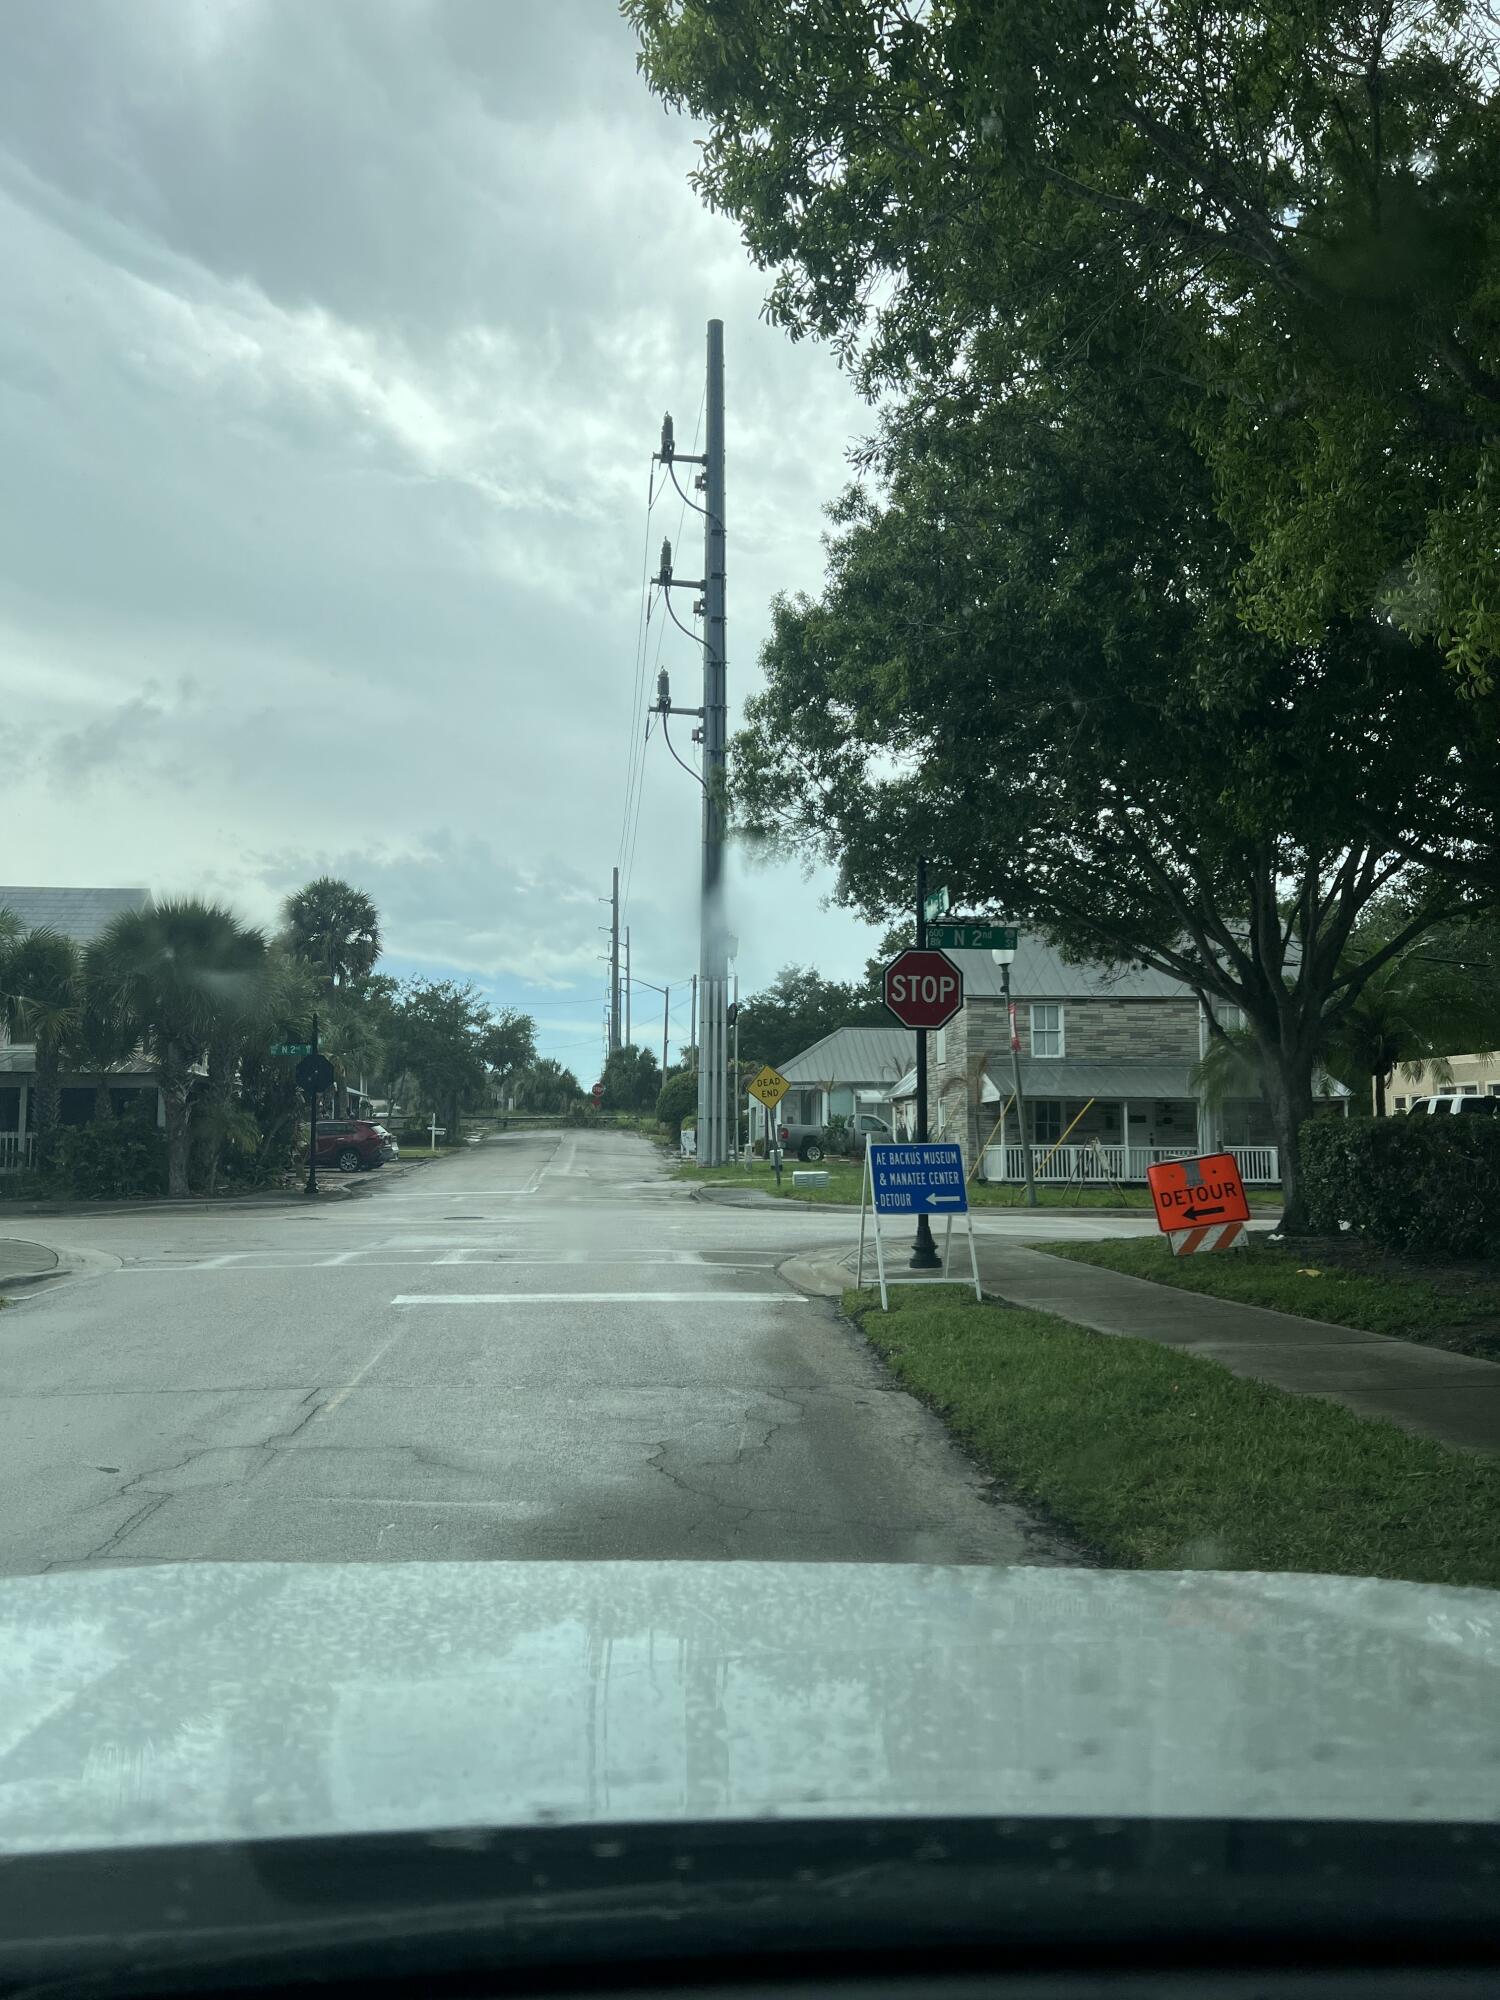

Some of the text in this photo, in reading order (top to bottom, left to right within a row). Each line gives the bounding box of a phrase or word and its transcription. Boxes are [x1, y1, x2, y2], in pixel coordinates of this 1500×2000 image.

[929, 928, 944, 937] 600
[953, 929, 992, 946] N 2nd
[891, 975, 955, 1003] STOP
[757, 1078, 780, 1087] DEAD
[761, 1089, 779, 1098] END
[876, 1151, 957, 1166] AE BACKUS MUSEUM
[880, 1171, 960, 1186] & MANATEE CENTER
[880, 1193, 912, 1207] DETOUR
[1160, 1183, 1237, 1207] DETOUR
